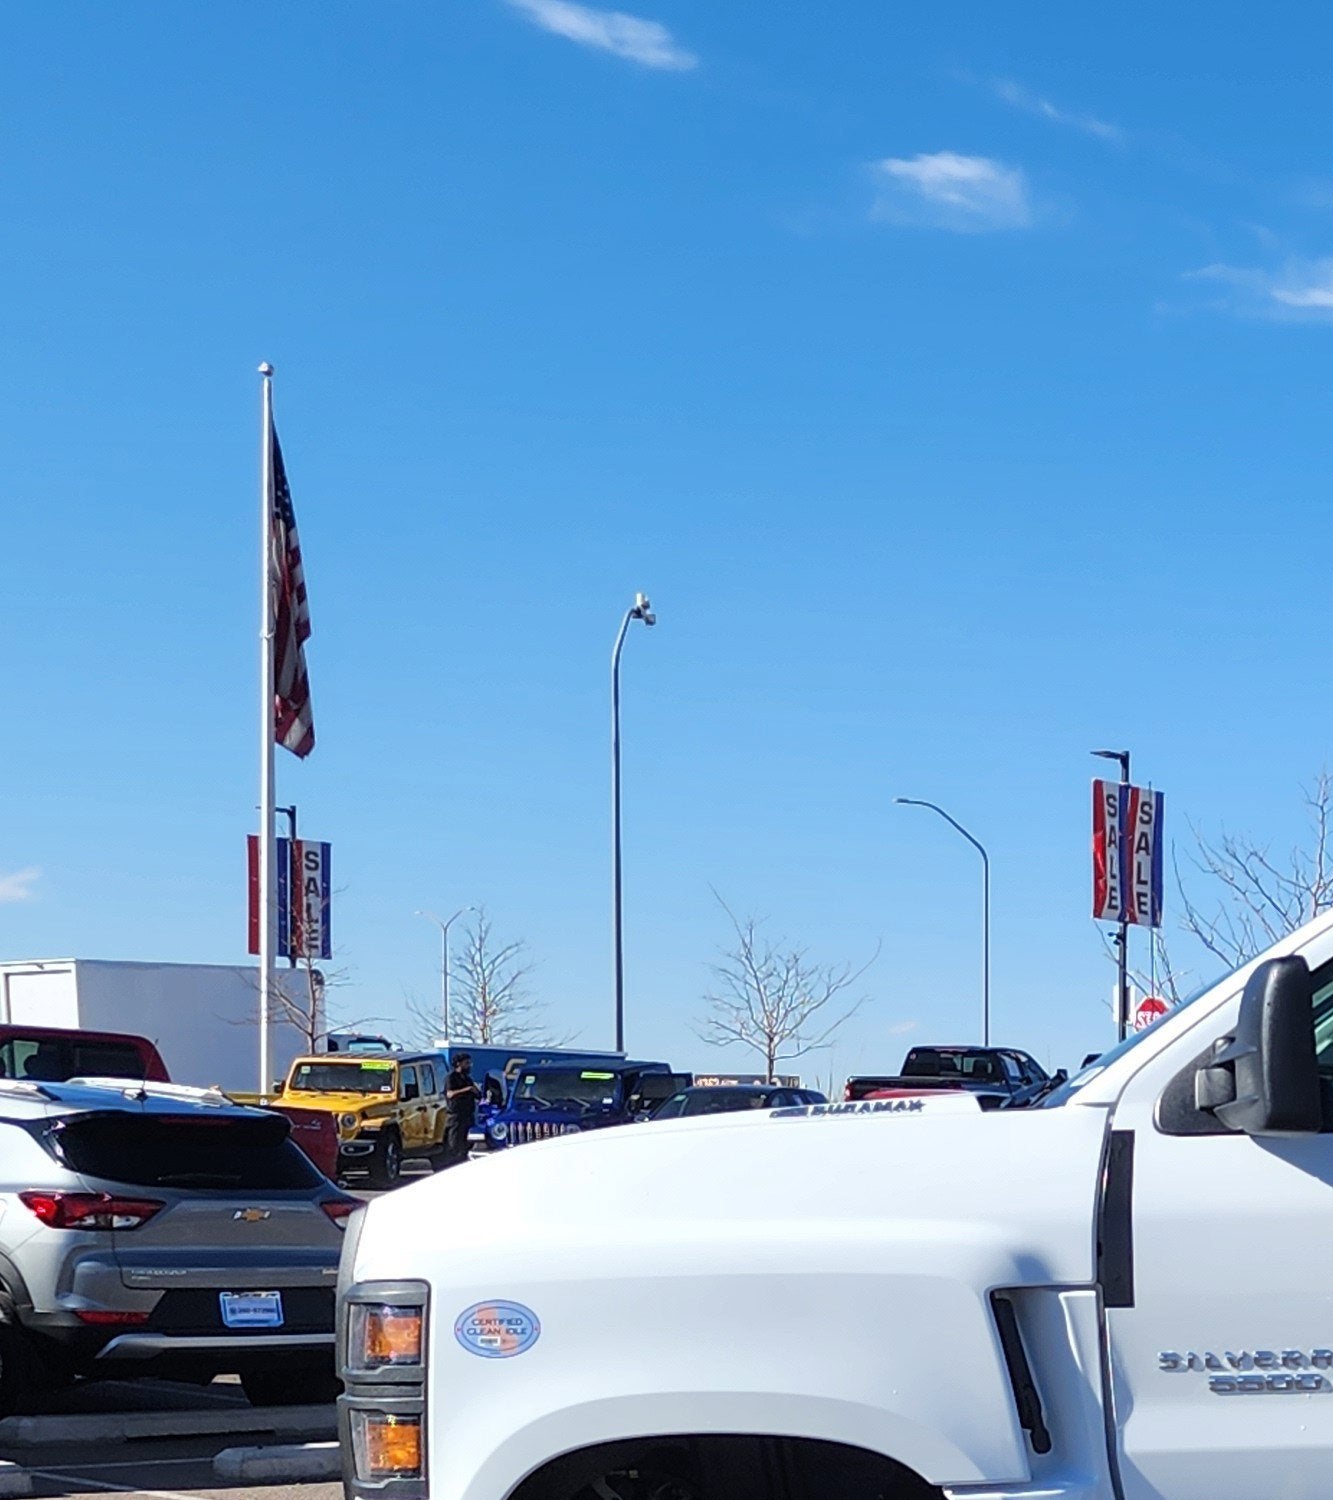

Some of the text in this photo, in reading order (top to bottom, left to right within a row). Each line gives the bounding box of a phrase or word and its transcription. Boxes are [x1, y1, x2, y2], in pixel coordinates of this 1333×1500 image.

[303, 850, 320, 950] SALE
[1105, 793, 1119, 911] SALE
[1135, 800, 1153, 916] SALE
[466, 1327, 528, 1336] CLEAN IDLE
[471, 1317, 523, 1327] CERTIFIED
